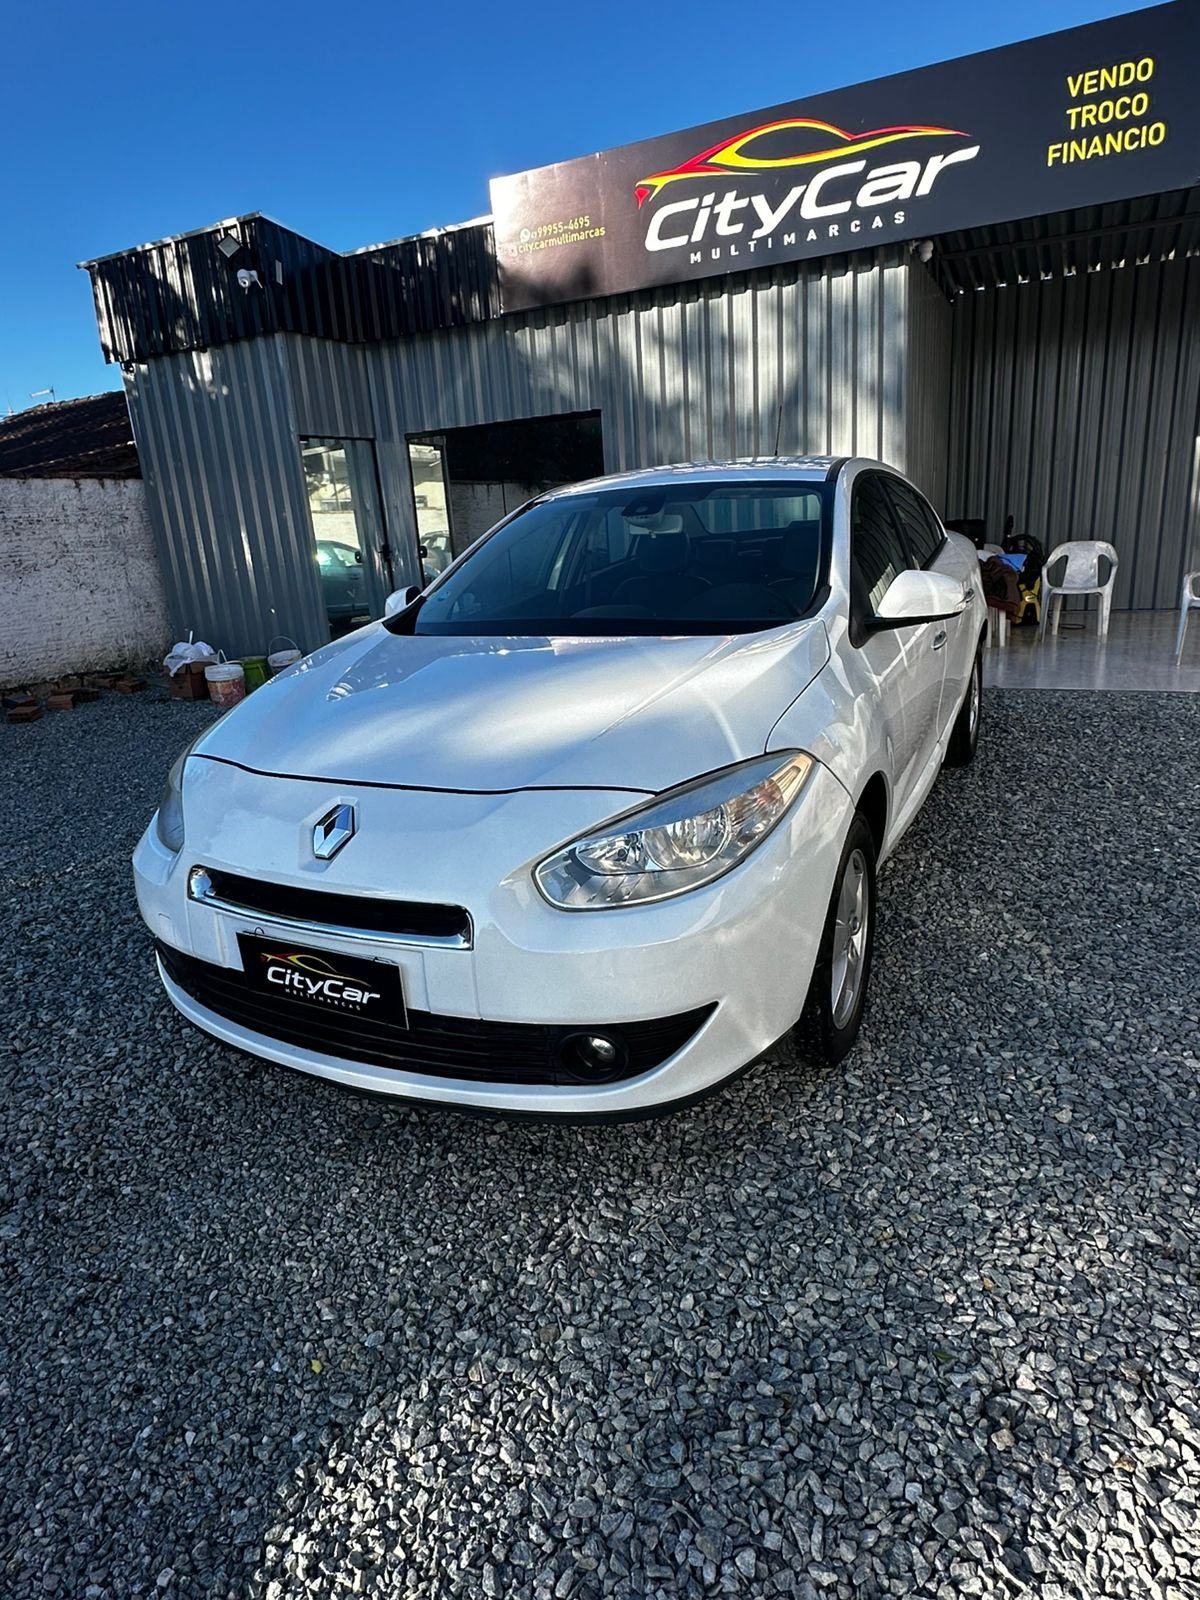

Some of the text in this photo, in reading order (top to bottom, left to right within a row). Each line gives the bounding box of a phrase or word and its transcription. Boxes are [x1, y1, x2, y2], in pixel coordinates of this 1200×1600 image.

[1067, 57, 1154, 98] VENDO
[1066, 92, 1149, 130] TROCO
[1047, 122, 1166, 167] FINANCIO
[644, 145, 981, 252] CityCar
[689, 210, 906, 264] MULTIMARCAS
[266, 966, 381, 1005] CityCar
